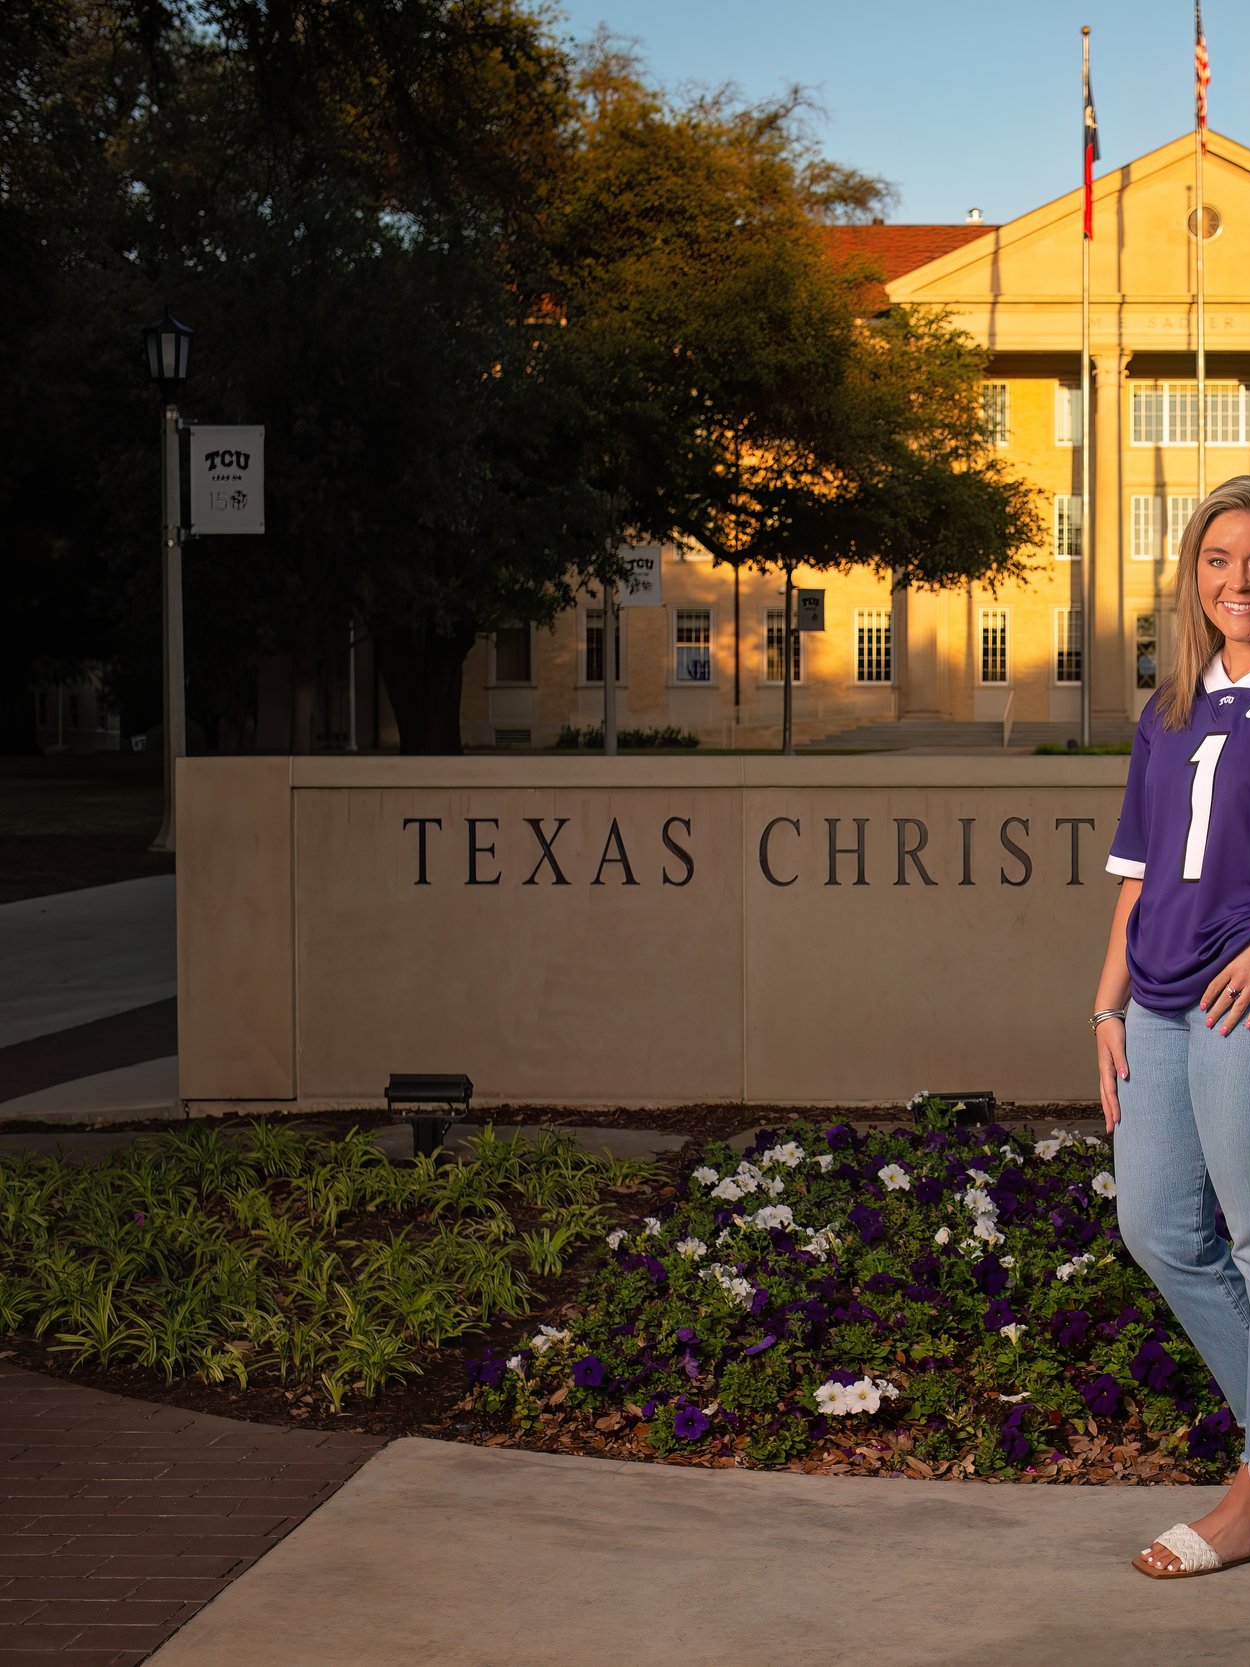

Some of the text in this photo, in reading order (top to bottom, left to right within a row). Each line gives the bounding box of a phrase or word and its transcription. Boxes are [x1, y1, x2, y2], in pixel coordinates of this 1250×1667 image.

[1147, 317, 1233, 329] SADER
[204, 450, 251, 472] TCU
[1219, 695, 1235, 706] TCU
[1183, 732, 1231, 882] 1
[402, 816, 695, 887] TEXAS
[759, 816, 1123, 887] CHRIST
